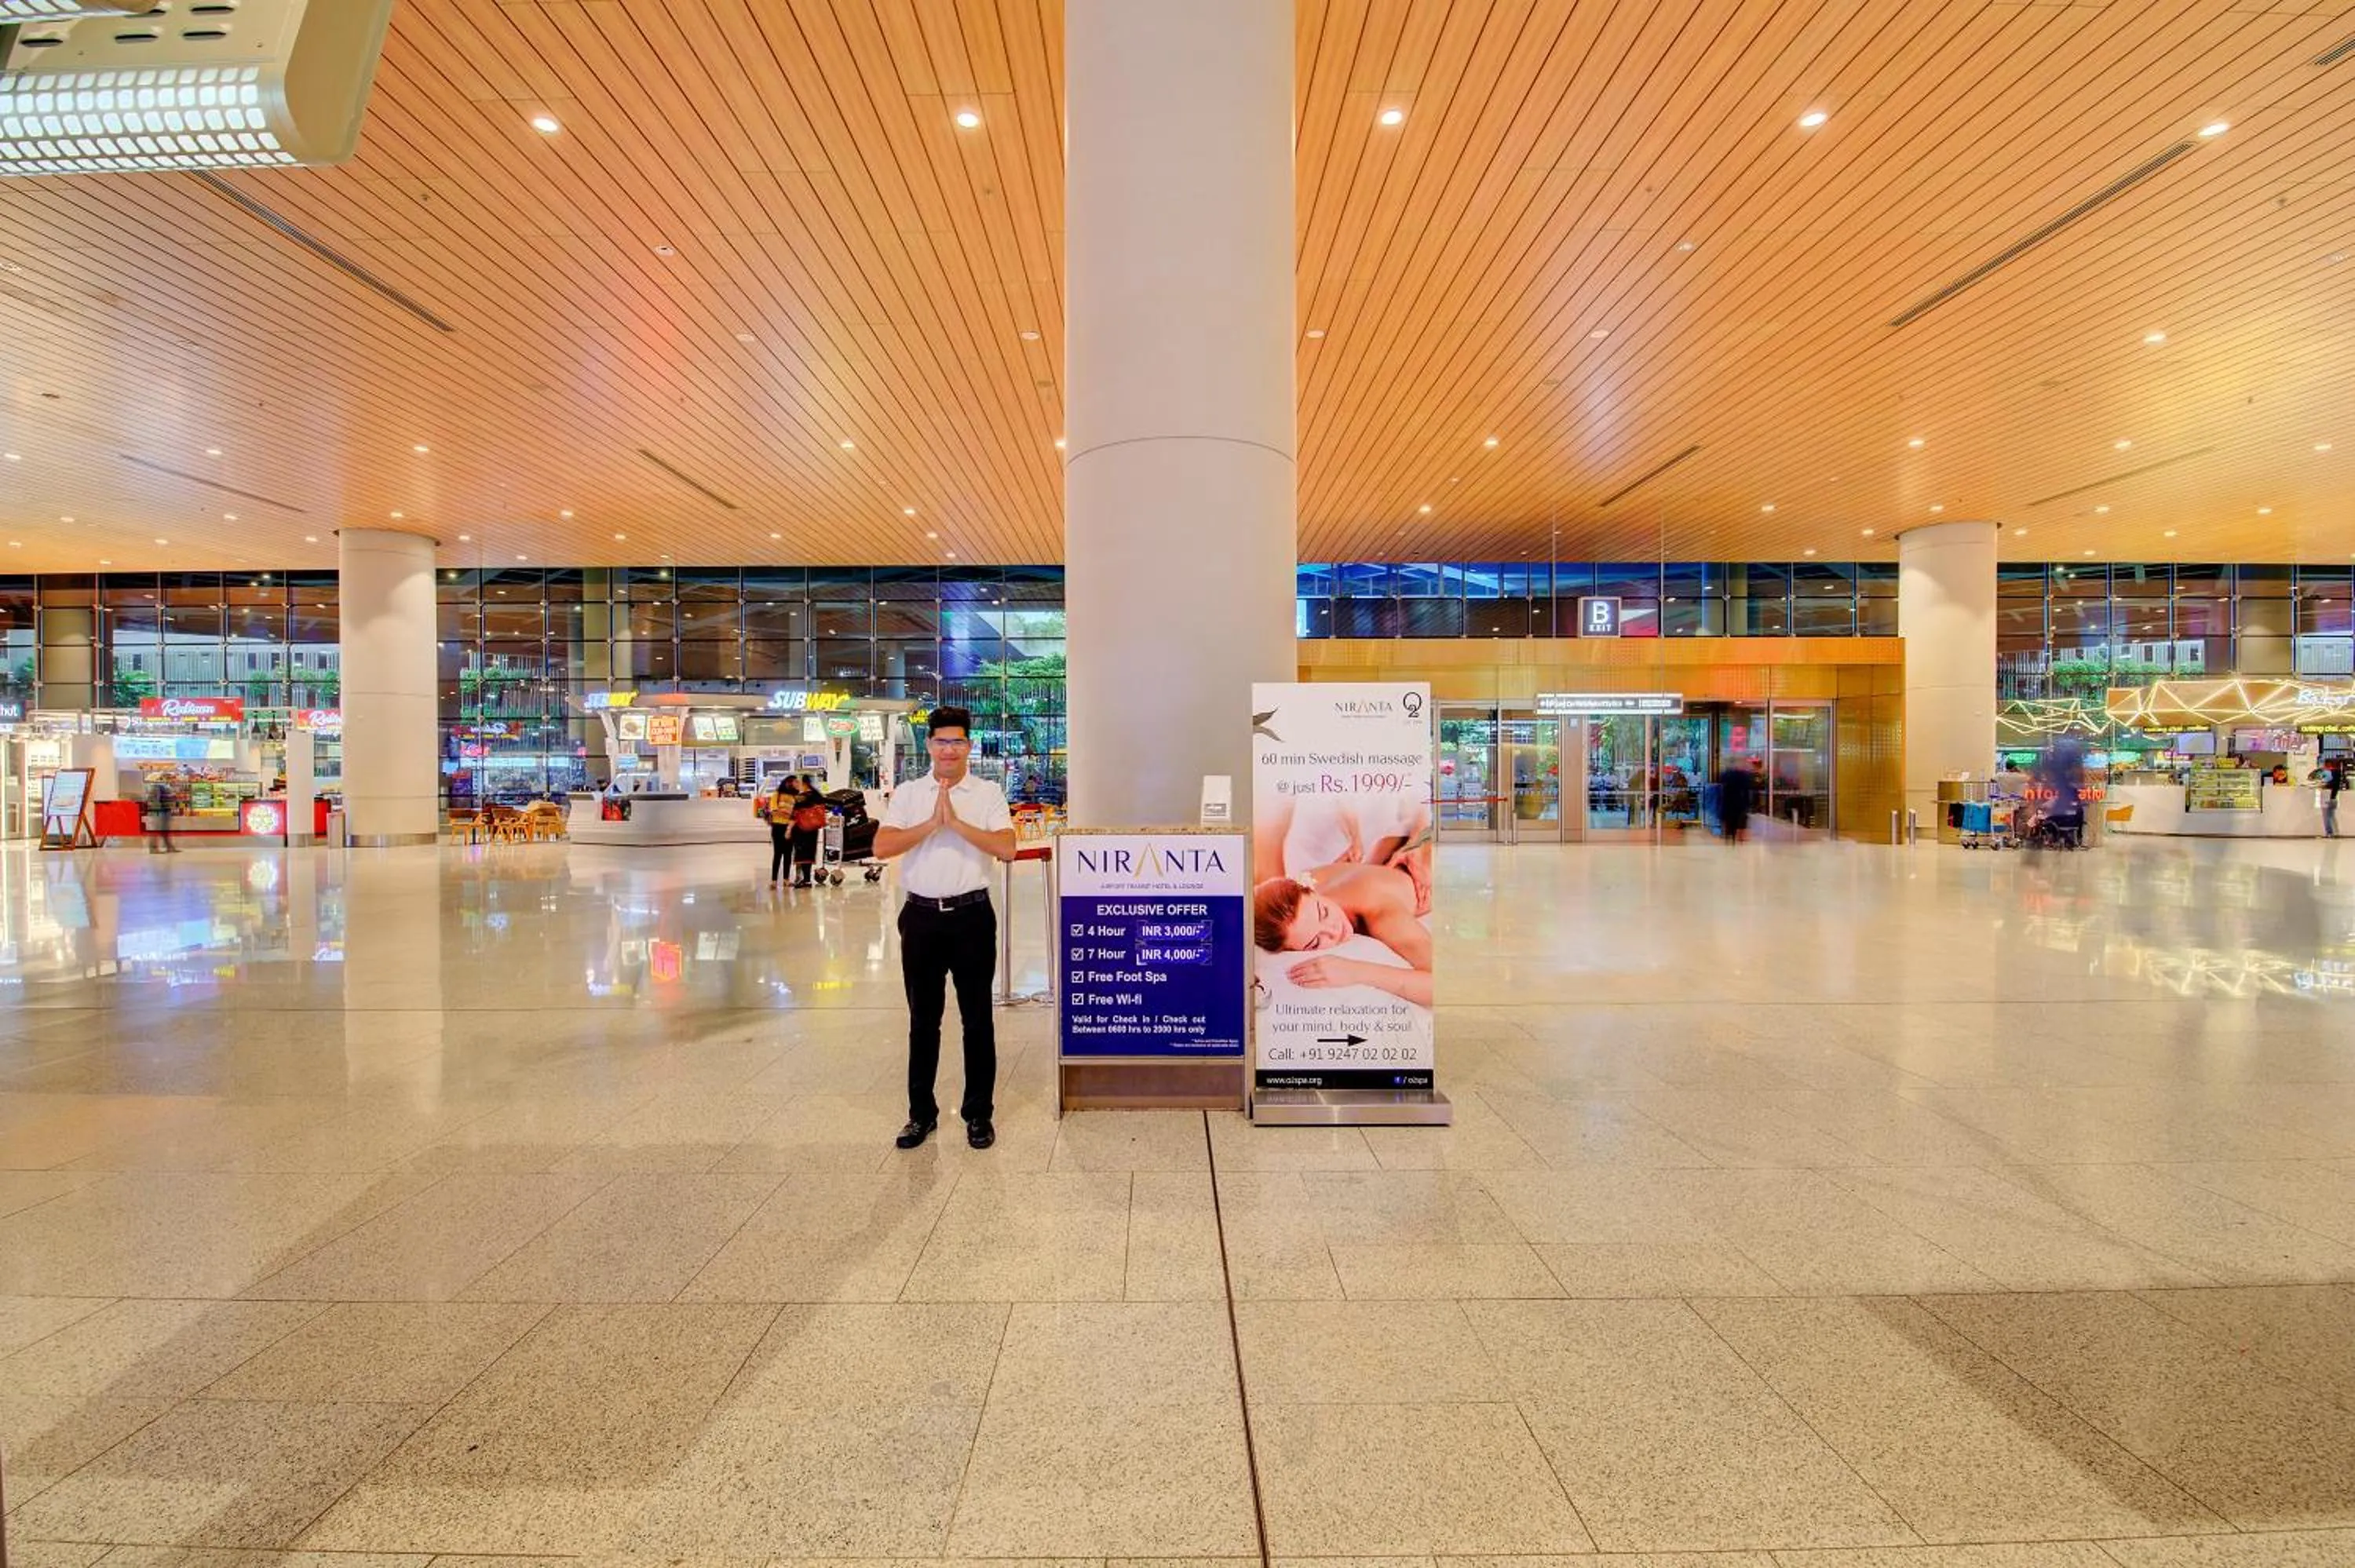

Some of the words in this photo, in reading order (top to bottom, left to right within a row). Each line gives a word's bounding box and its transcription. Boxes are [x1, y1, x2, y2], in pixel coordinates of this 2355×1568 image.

[1593, 601, 1609, 625] B
[768, 691, 850, 711] SUBWAY
[1334, 700, 1393, 713] NIRANTA
[1261, 753, 1278, 765] 60
[1280, 753, 1305, 765] min
[1309, 752, 1364, 766] Swedish
[1367, 754, 1422, 768] massage
[1277, 780, 1290, 793] @
[1292, 781, 1316, 795] just
[1078, 843, 1226, 879] NIRANTA
[1097, 903, 1164, 916] EXCLUSIVE
[1167, 903, 1208, 916] OFFER
[1087, 925, 1095, 936] 4
[1097, 925, 1126, 936] Hour
[1142, 925, 1163, 936] INR
[1087, 948, 1095, 959] 7
[1097, 948, 1126, 959] Hour
[1142, 949, 1162, 960] INR
[1088, 971, 1114, 982] Free
[1115, 971, 1143, 982] Foot
[1145, 971, 1168, 985] Spa
[1088, 994, 1114, 1005] Free
[1115, 993, 1142, 1005] Wi-fi
[1275, 1004, 1327, 1016] Ultimate
[1328, 1004, 1388, 1016] relaxation
[1390, 1004, 1410, 1016] for
[1072, 1015, 1092, 1023] Valid
[1096, 1015, 1108, 1023] for
[1112, 1015, 1137, 1023] Check
[1162, 1015, 1188, 1023] Check
[1072, 1025, 1106, 1034] Between
[1128, 1024, 1142, 1034] hrs
[1143, 1025, 1152, 1034] to
[1173, 1024, 1187, 1034] hrs
[1188, 1025, 1206, 1035] only
[1272, 1023, 1299, 1034] your
[1340, 1020, 1371, 1034] body
[1373, 1020, 1385, 1032] &
[1386, 1020, 1412, 1032] soul
[1268, 1048, 1295, 1060] Call:
[1299, 1048, 1324, 1060] +91
[1327, 1048, 1360, 1060] 9247
[1362, 1048, 1378, 1060] 02
[1381, 1048, 1398, 1061] 02
[1400, 1048, 1417, 1060] 02
